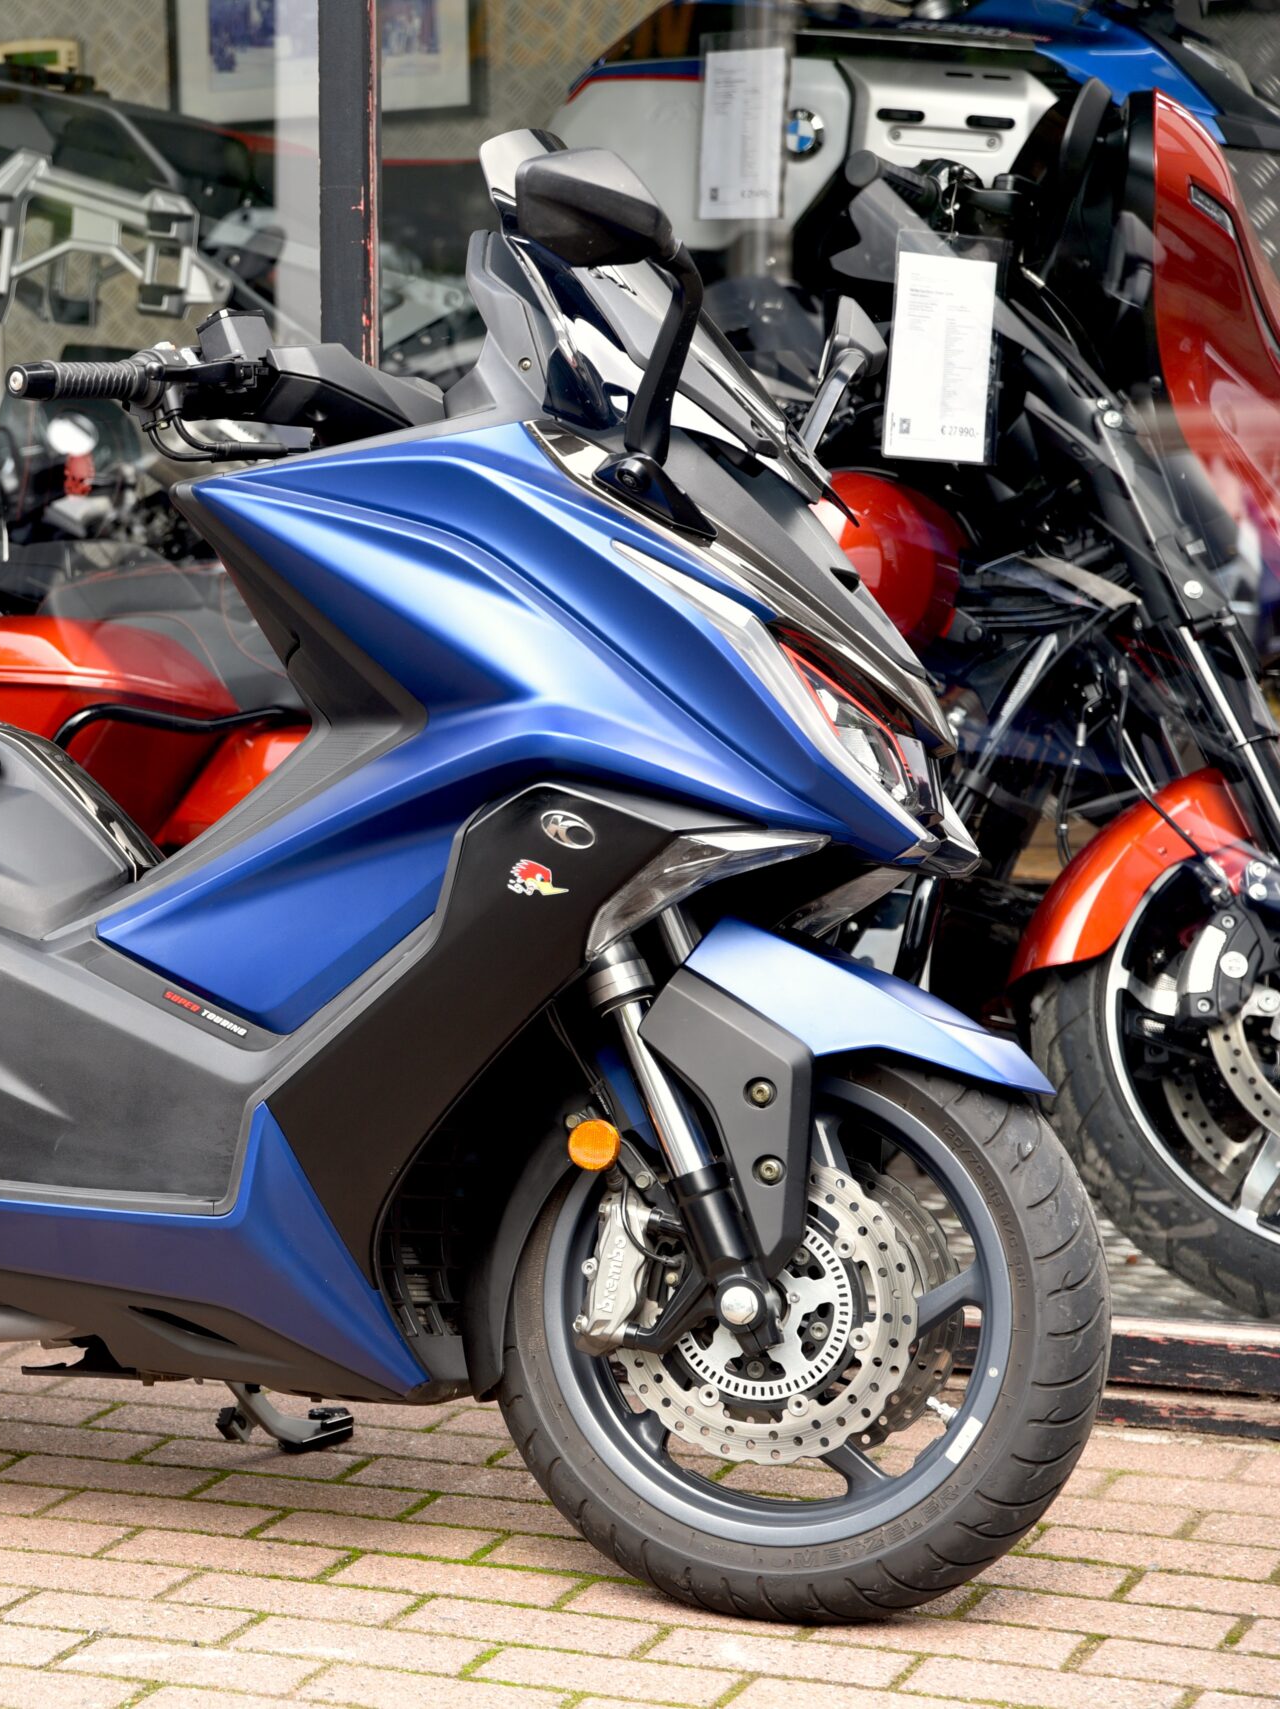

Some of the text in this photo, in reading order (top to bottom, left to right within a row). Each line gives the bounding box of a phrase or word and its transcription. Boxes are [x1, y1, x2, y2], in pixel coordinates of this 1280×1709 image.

[163, 991, 248, 1037] SUPER TOURING
[596, 1235, 627, 1314] brembo
[793, 1484, 959, 1569] METZELER
